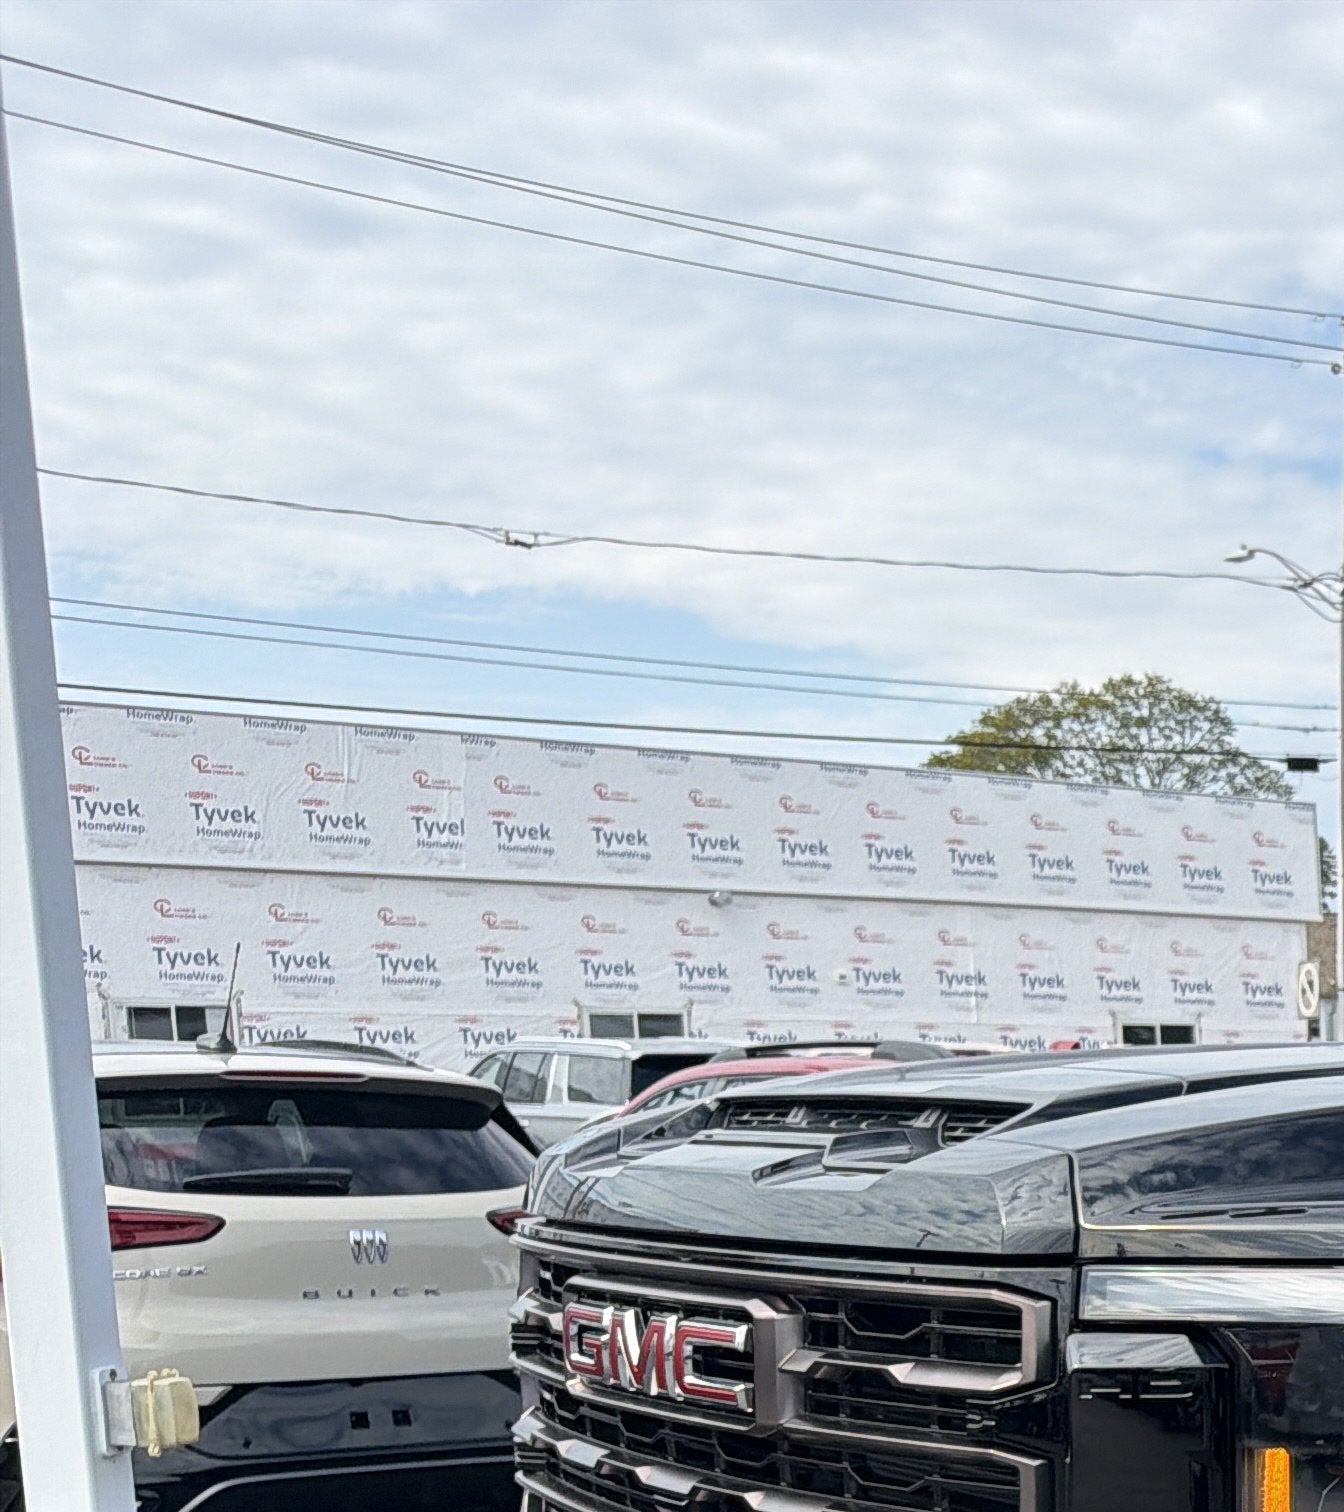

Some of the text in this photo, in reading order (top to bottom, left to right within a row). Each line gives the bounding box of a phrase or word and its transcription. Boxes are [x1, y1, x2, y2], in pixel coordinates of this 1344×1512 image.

[70, 795, 142, 820] Tyvek
[189, 802, 257, 826] Tyvek
[77, 820, 146, 835] HomeWrap
[303, 809, 367, 832] Tyvek
[196, 826, 263, 841] HomeWrap
[309, 832, 371, 847] HomeWrap
[492, 820, 551, 843] Tyvek
[592, 826, 648, 849] Tyvek
[687, 832, 741, 854] Tyvek
[777, 837, 829, 859] Tyvek
[865, 842, 914, 864] Tyvek
[948, 848, 996, 868] Tyvek
[1028, 853, 1074, 872] Tyvek
[1106, 858, 1150, 877] Tyvek
[1180, 863, 1222, 882] Tyvek
[1251, 869, 1292, 887] Tyvek
[152, 946, 220, 970] Tyvek
[266, 950, 332, 973] Tyvek
[376, 953, 437, 976] Tyvek
[480, 956, 539, 977] Tyvek
[158, 970, 226, 984] HomeWrap
[580, 958, 636, 980] Tyvek
[674, 960, 728, 982] Tyvek
[765, 963, 817, 984] Tyvek
[852, 967, 902, 987] Tyvek
[273, 973, 335, 987] HomeWrap
[382, 975, 442, 989] HomeWrap
[1018, 972, 1065, 989] Tyvek
[1097, 975, 1140, 993] Tyvek
[1170, 978, 1213, 996] Tyvek
[1242, 981, 1283, 998] Tyvek
[353, 1026, 416, 1045] Tyvek
[458, 1027, 517, 1049] Tyvek
[302, 1288, 440, 1300] BUICK
[562, 1301, 755, 1412] GMC
